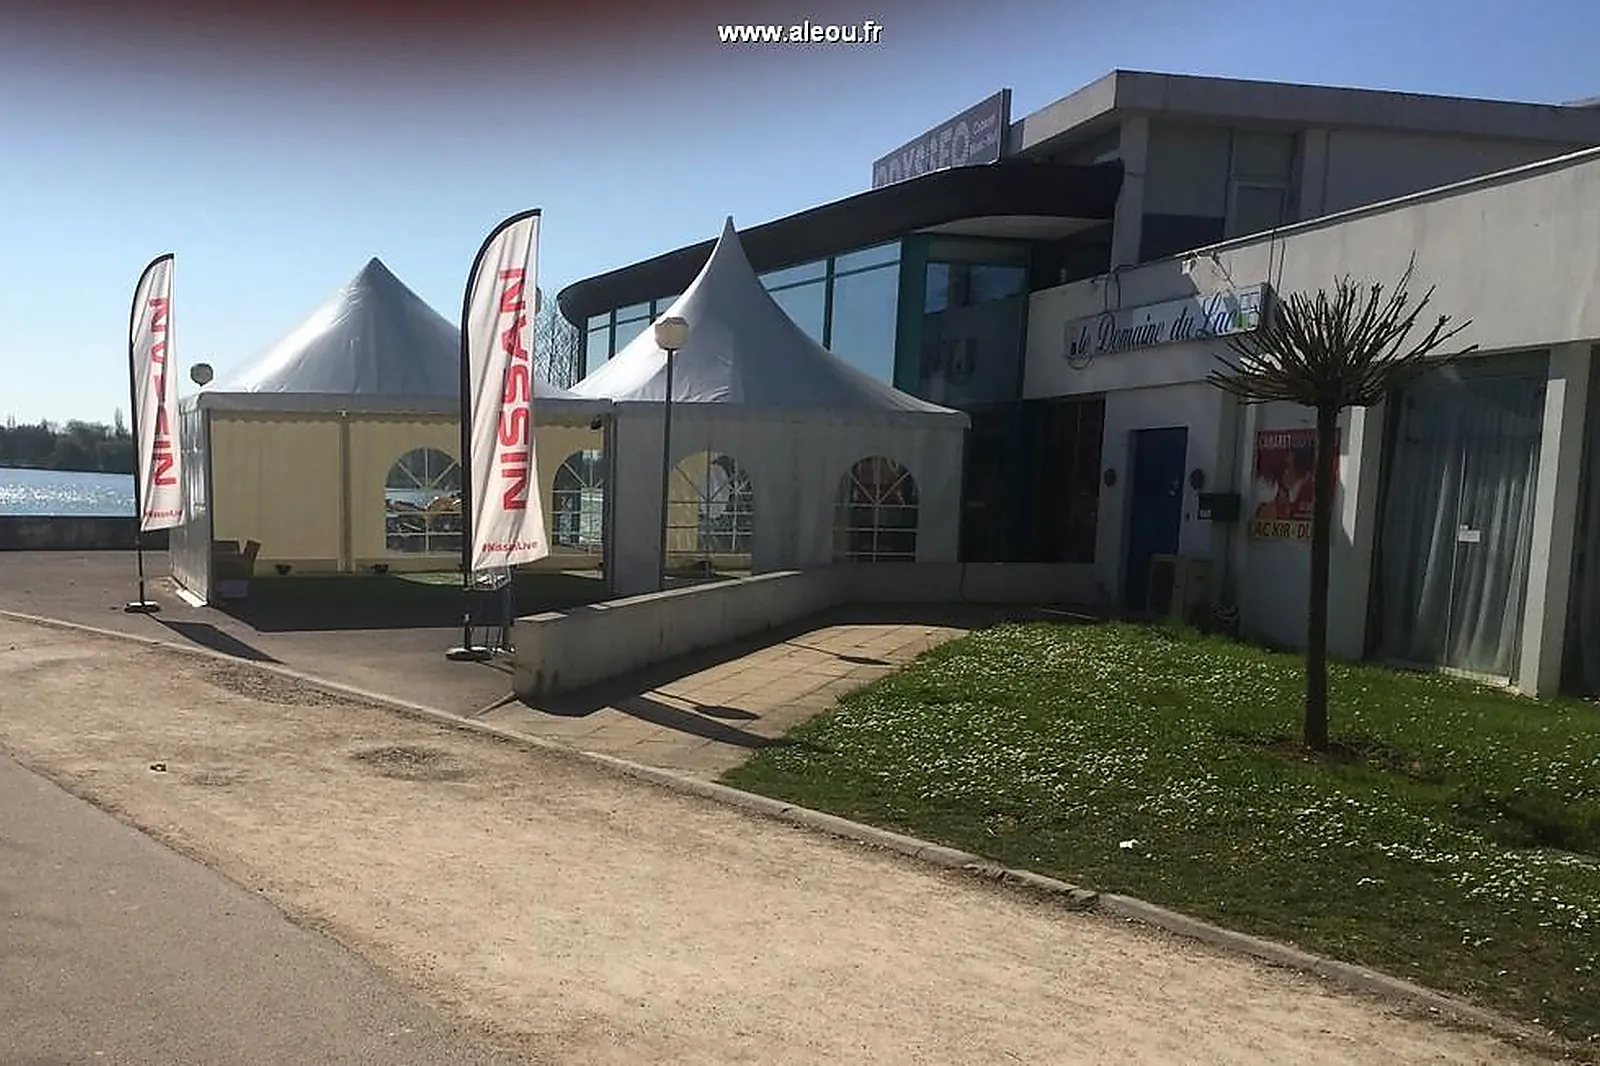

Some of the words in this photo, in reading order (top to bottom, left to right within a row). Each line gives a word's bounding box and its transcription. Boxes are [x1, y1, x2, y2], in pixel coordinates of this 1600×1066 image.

[150, 298, 176, 487] NIAN
[499, 268, 531, 511] NISSAN
[1098, 312, 1165, 354] Domaine
[1170, 307, 1194, 340] du
[1196, 290, 1238, 341] Lac
